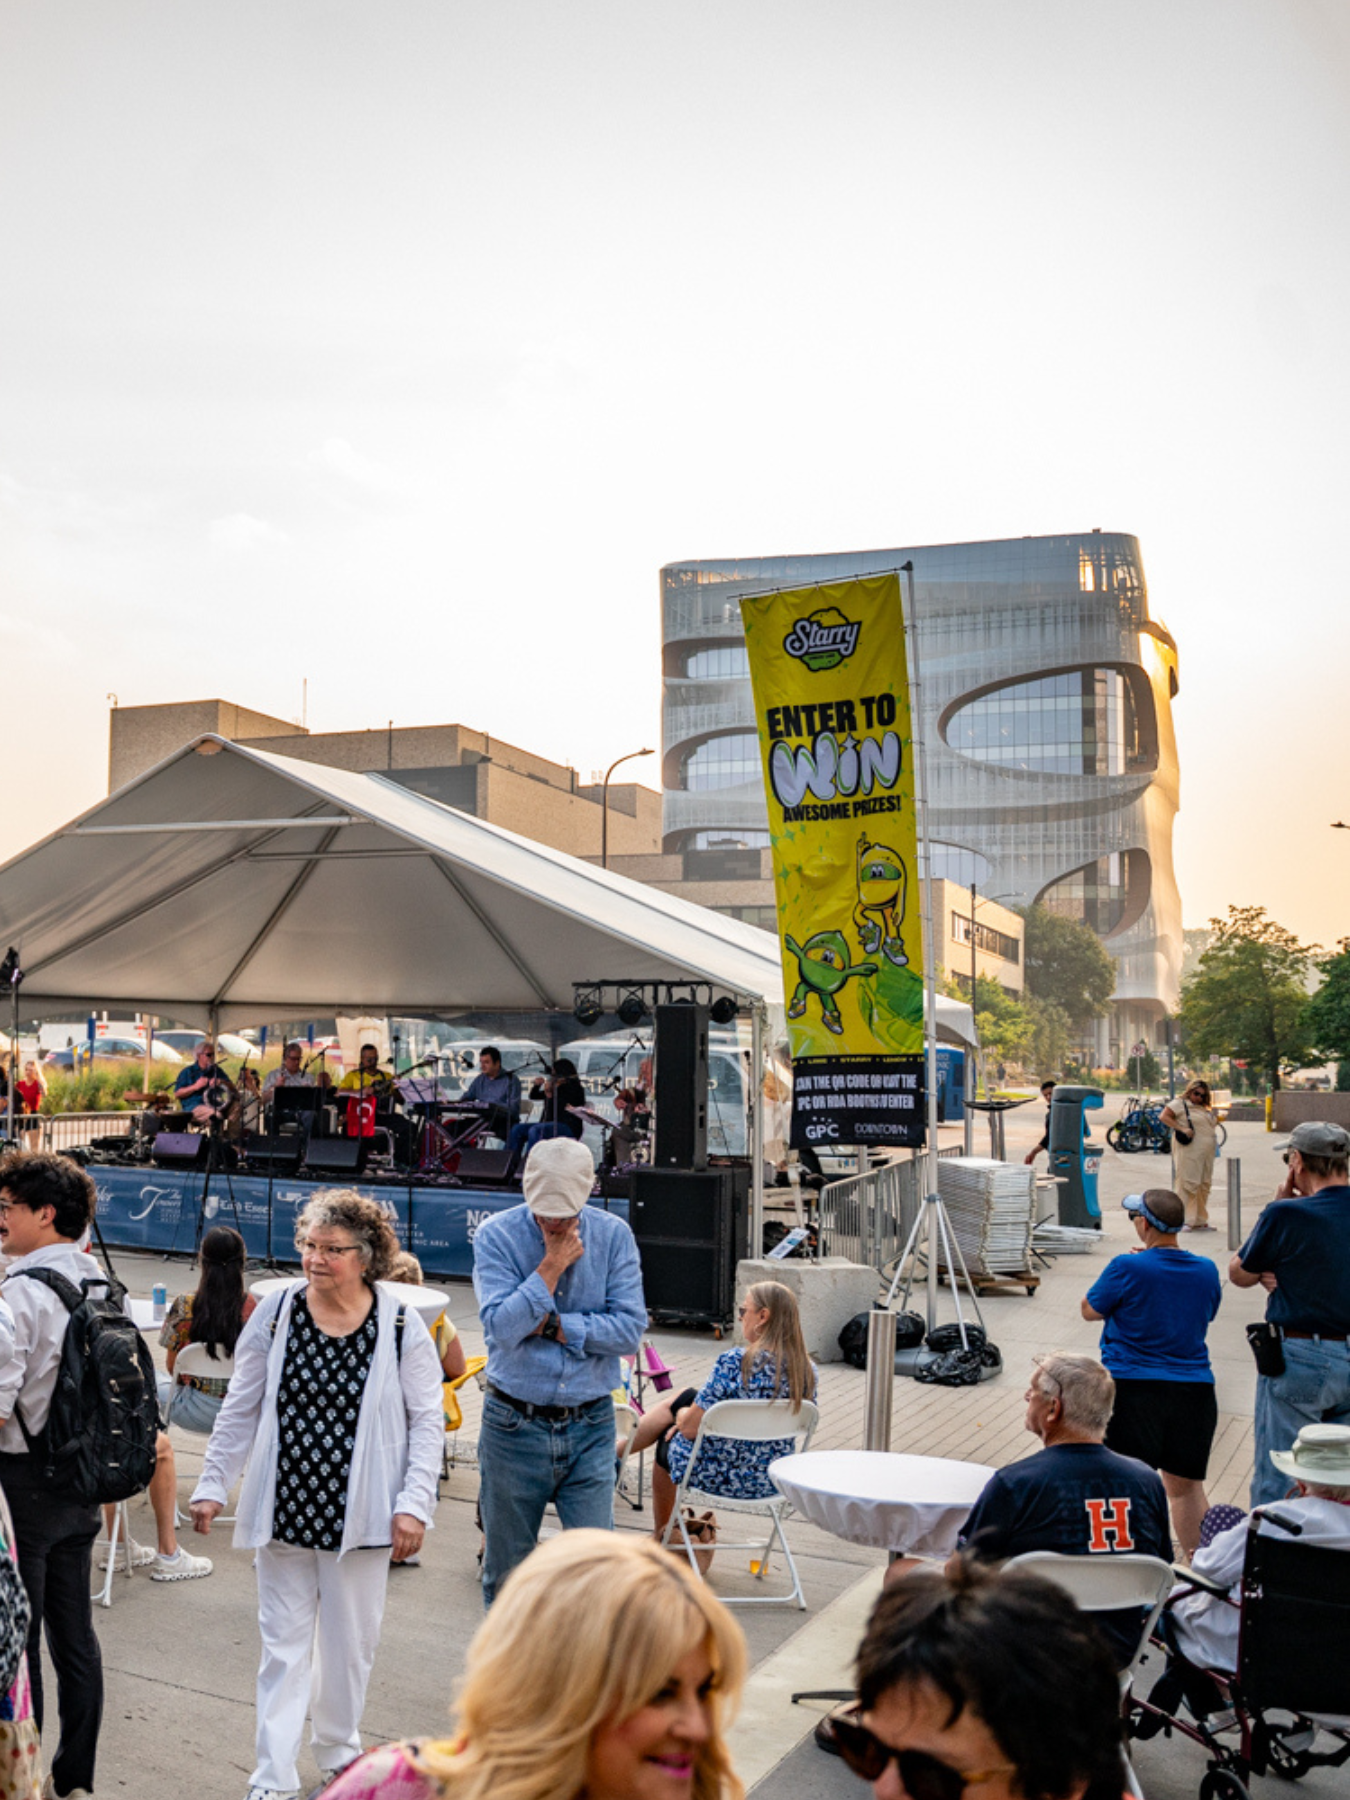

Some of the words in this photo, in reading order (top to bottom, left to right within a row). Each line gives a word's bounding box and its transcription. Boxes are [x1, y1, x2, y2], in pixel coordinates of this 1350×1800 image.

[785, 619, 859, 657] Starry
[766, 700, 857, 740] ENTER
[860, 693, 896, 729] TO
[783, 802, 851, 823] AWESOME
[853, 795, 901, 818] PRIZES!
[813, 1075, 831, 1090] THE
[805, 1124, 839, 1139] GPC
[1084, 1497, 1134, 1552] H
